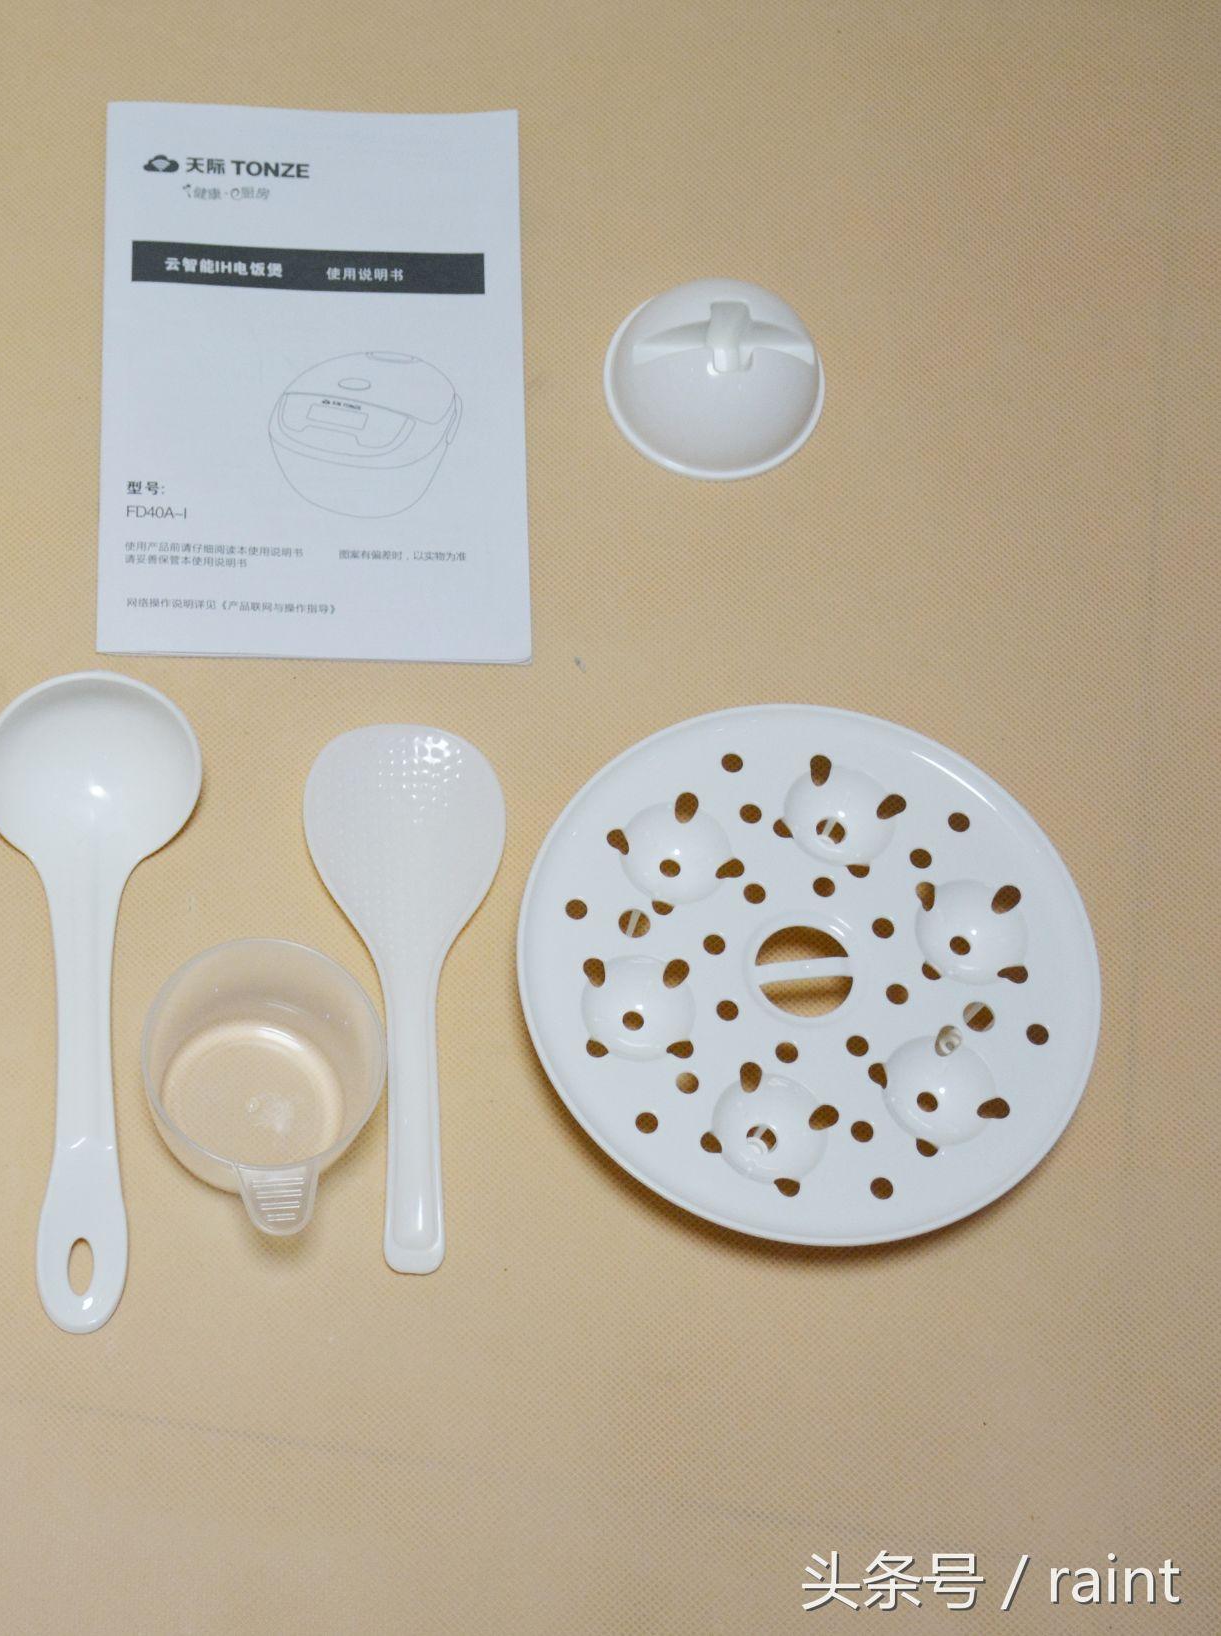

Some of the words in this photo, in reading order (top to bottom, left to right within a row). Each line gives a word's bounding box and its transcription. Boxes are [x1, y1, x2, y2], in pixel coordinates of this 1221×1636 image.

[186, 157, 225, 174] 天际
[231, 160, 310, 178] TONZE
[164, 256, 283, 279] 云智能IH电饭煲
[326, 266, 404, 282] 使用说明书
[125, 541, 304, 558] 使用产品前请仔细阅读本使用说明书
[125, 554, 248, 568] 请妥善保管本使用说明书
